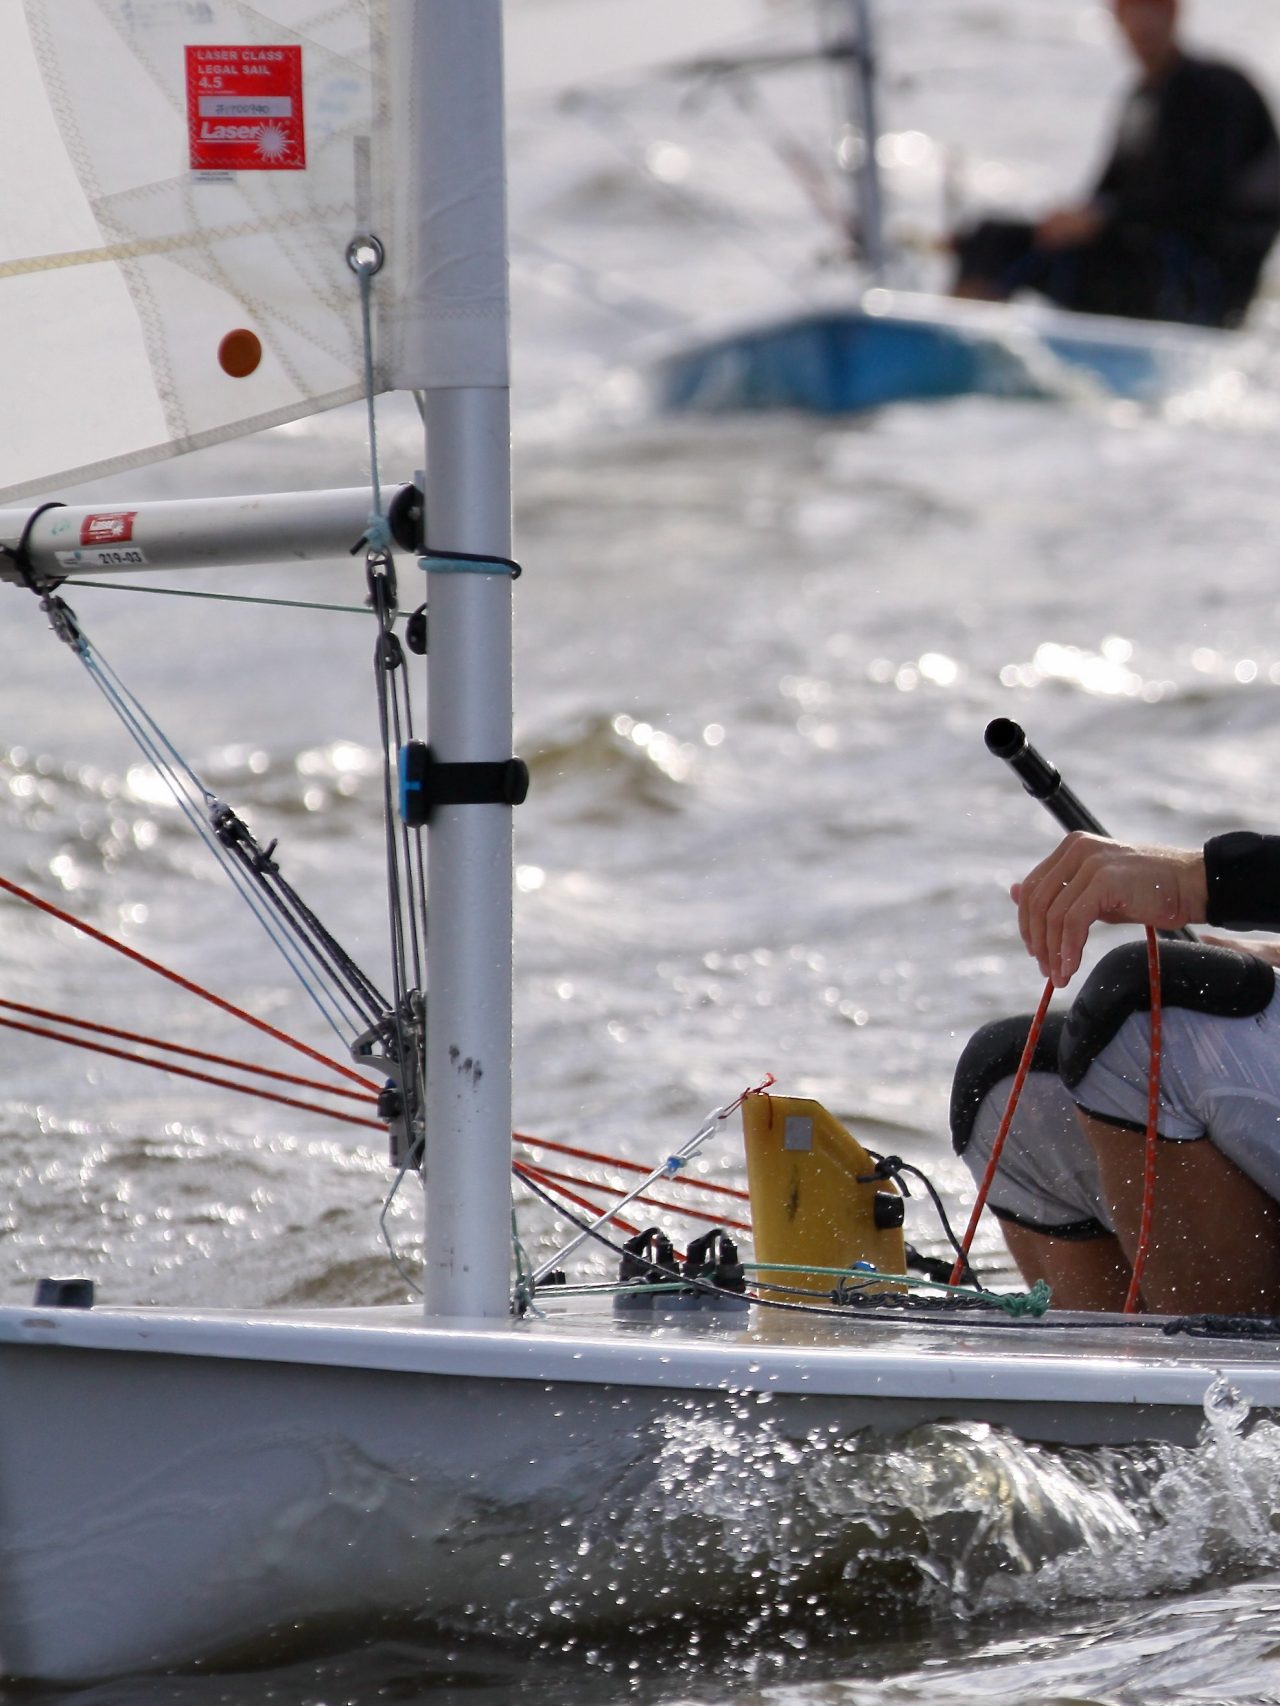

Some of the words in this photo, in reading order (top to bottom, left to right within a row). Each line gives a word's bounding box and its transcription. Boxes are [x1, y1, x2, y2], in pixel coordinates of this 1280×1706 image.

[197, 51, 238, 60] LASER
[241, 51, 283, 60] CLASS
[198, 65, 238, 74] LEGAL
[242, 65, 271, 75] SAIL
[198, 76, 223, 88] 4.5
[200, 121, 262, 139] Laser
[98, 551, 142, 565] 219-03
